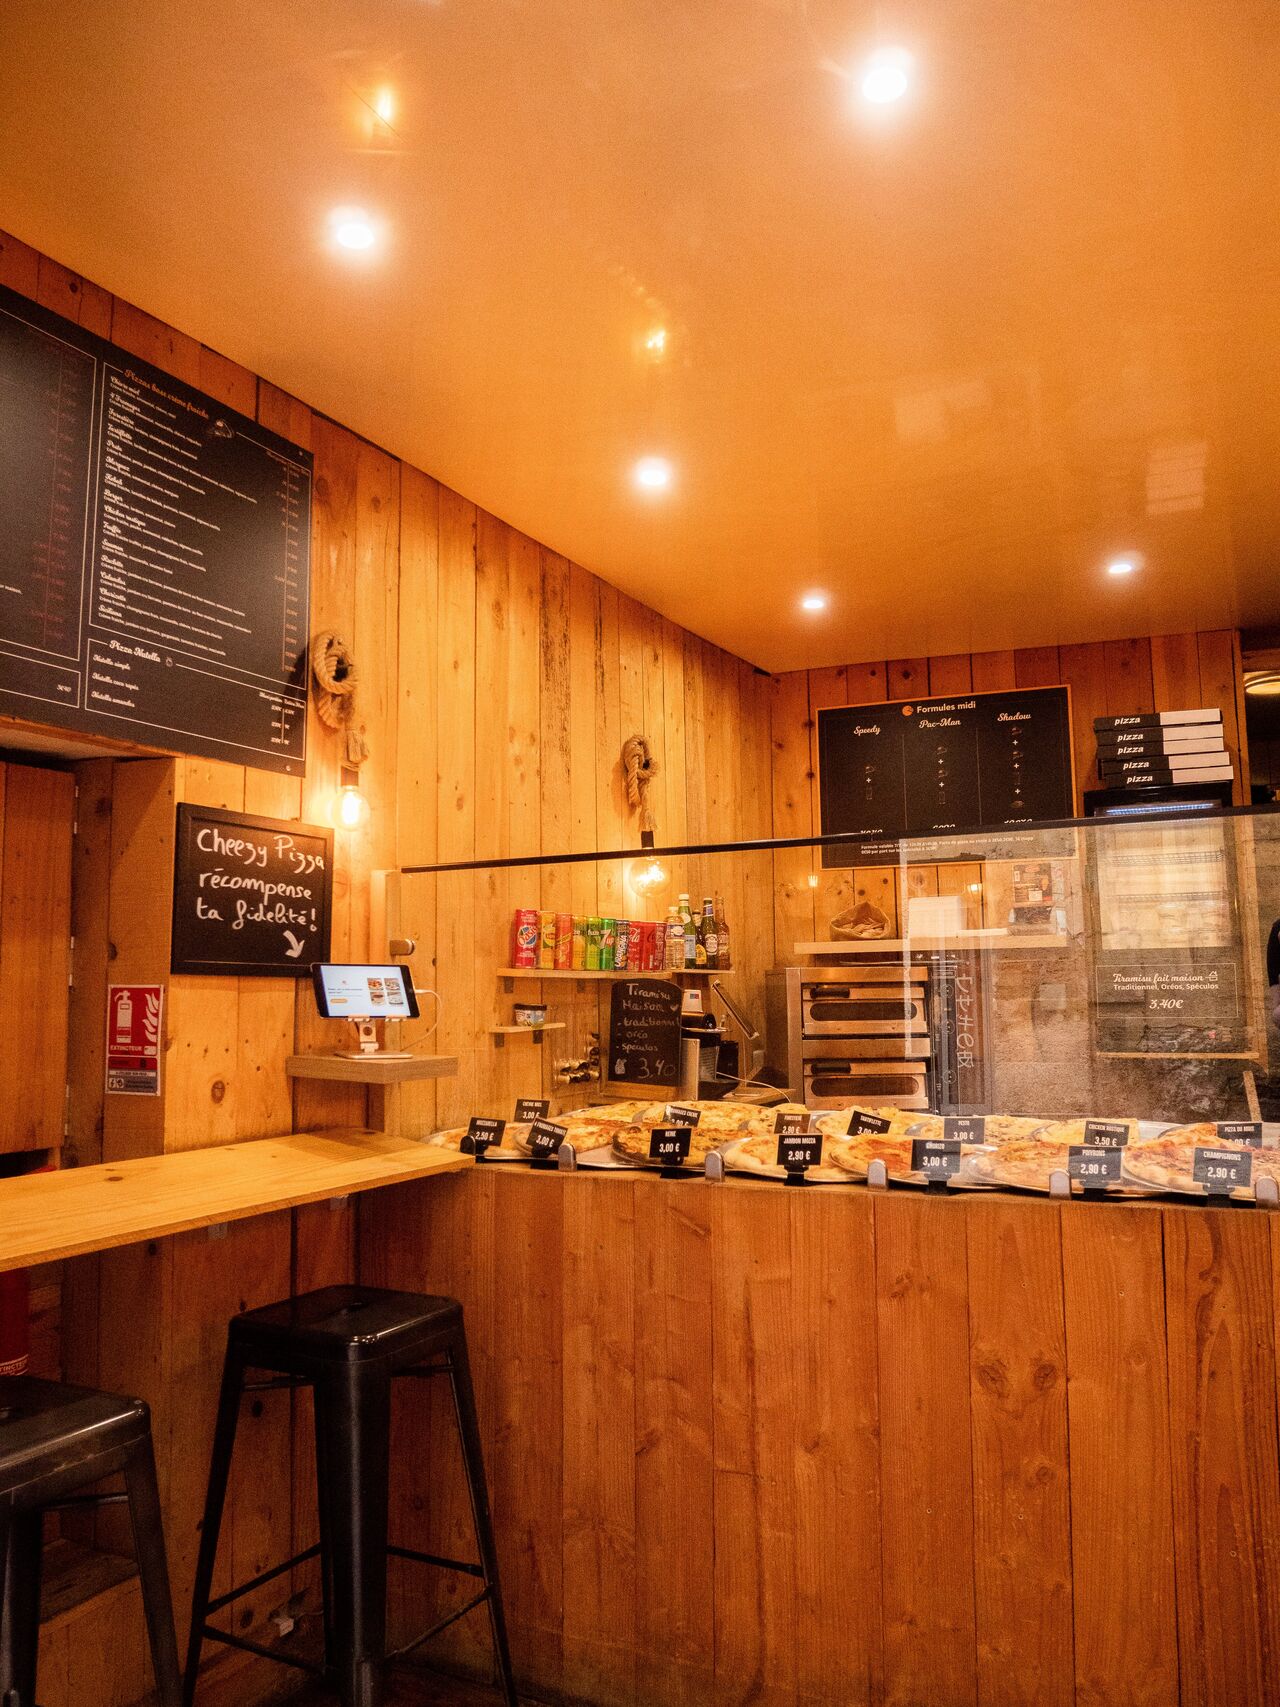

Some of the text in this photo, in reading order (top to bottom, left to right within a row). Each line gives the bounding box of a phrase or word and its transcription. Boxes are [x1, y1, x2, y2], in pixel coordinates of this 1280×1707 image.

[109, 640, 161, 662] Pizza Nutella
[916, 701, 976, 714] Formules midi
[997, 713, 1031, 722] Shadow
[1115, 717, 1140, 726] pizza
[919, 718, 961, 729] Pac-Man
[854, 725, 881, 736] Speedy
[1117, 733, 1143, 742] pizza
[1118, 746, 1143, 755] pizza
[1123, 761, 1149, 770] pizza
[1127, 775, 1153, 784] pizza
[197, 829, 324, 874] Cheezy Pizza
[199, 869, 312, 905] récompense
[196, 897, 224, 921] ta
[1113, 973, 1203, 987] Tiramisu fait maison
[626, 983, 671, 1000] Tiramisu
[1161, 983, 1184, 991] Oréos,
[1186, 982, 1219, 991] Spéculos
[489, 1132, 494, 1141] €
[969, 1132, 974, 1140] €
[1094, 1136, 1117, 1146] 3,50 €
[549, 1139, 554, 1148] €
[659, 1143, 680, 1152] 3,00 €
[788, 1150, 811, 1160] 2,90 €
[1203, 1151, 1241, 1160] CHAMPIGNONS
[923, 1156, 948, 1167] 3,00 €
[1101, 1165, 1107, 1175] €
[1207, 1167, 1237, 1179] 2,90 €
